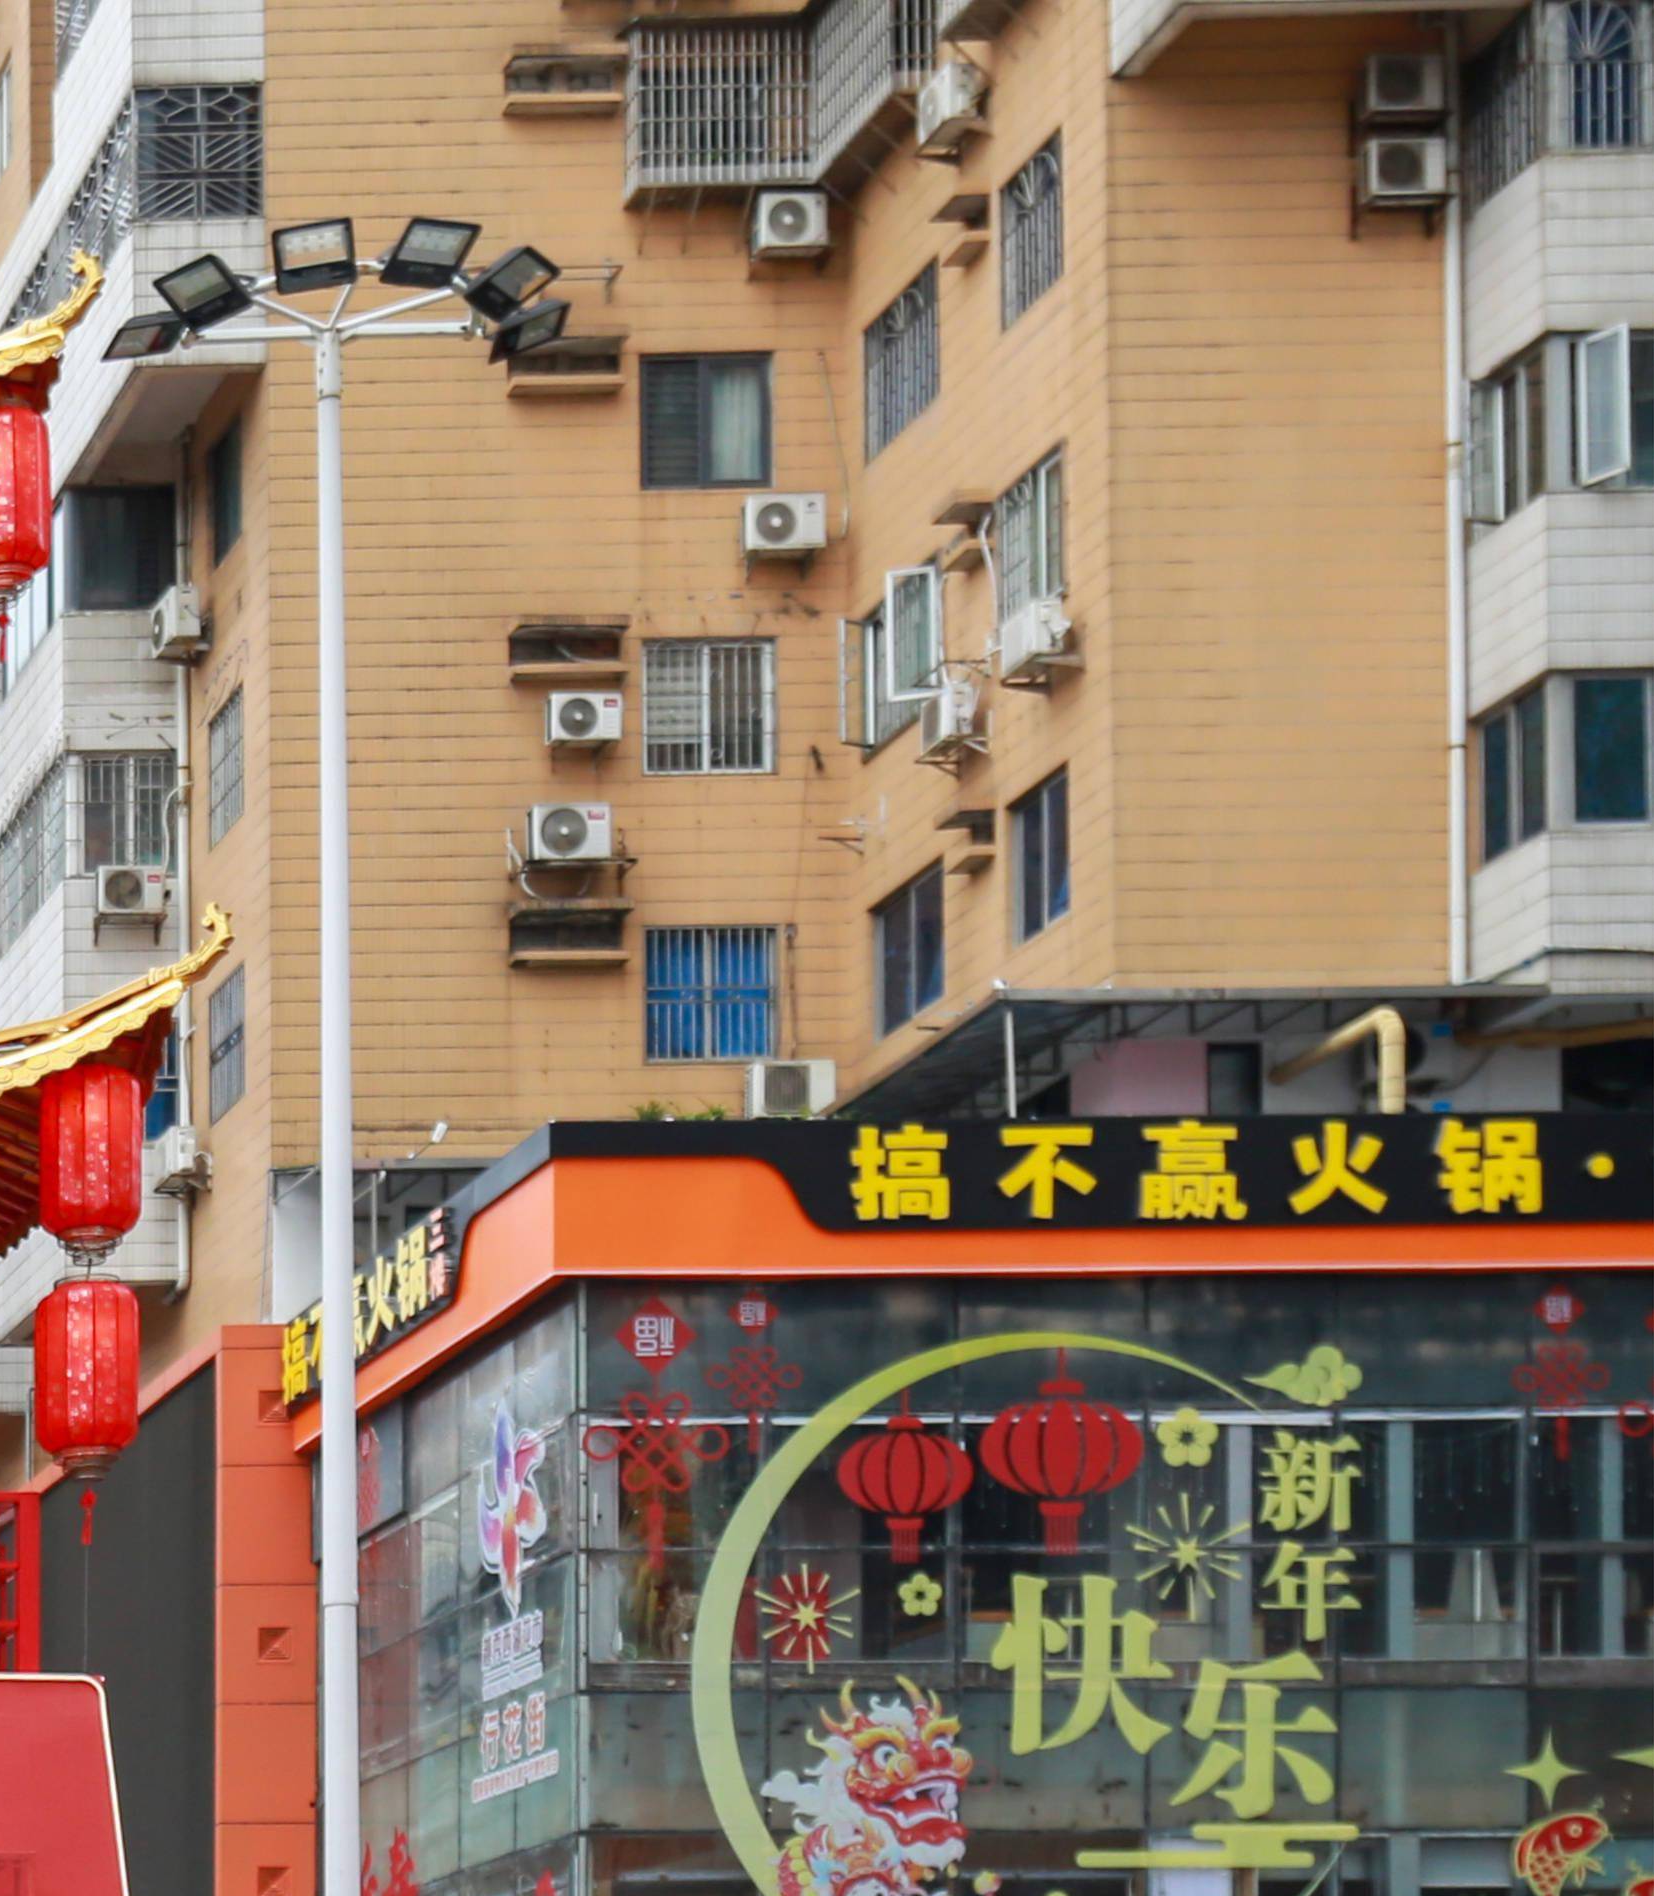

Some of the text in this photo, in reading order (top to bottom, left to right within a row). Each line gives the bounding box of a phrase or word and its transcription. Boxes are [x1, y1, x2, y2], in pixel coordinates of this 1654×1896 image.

[282, 1225, 429, 1406] 搞火锅
[1259, 1428, 1362, 1643] 新年
[991, 1574, 1338, 1816] 快乐
